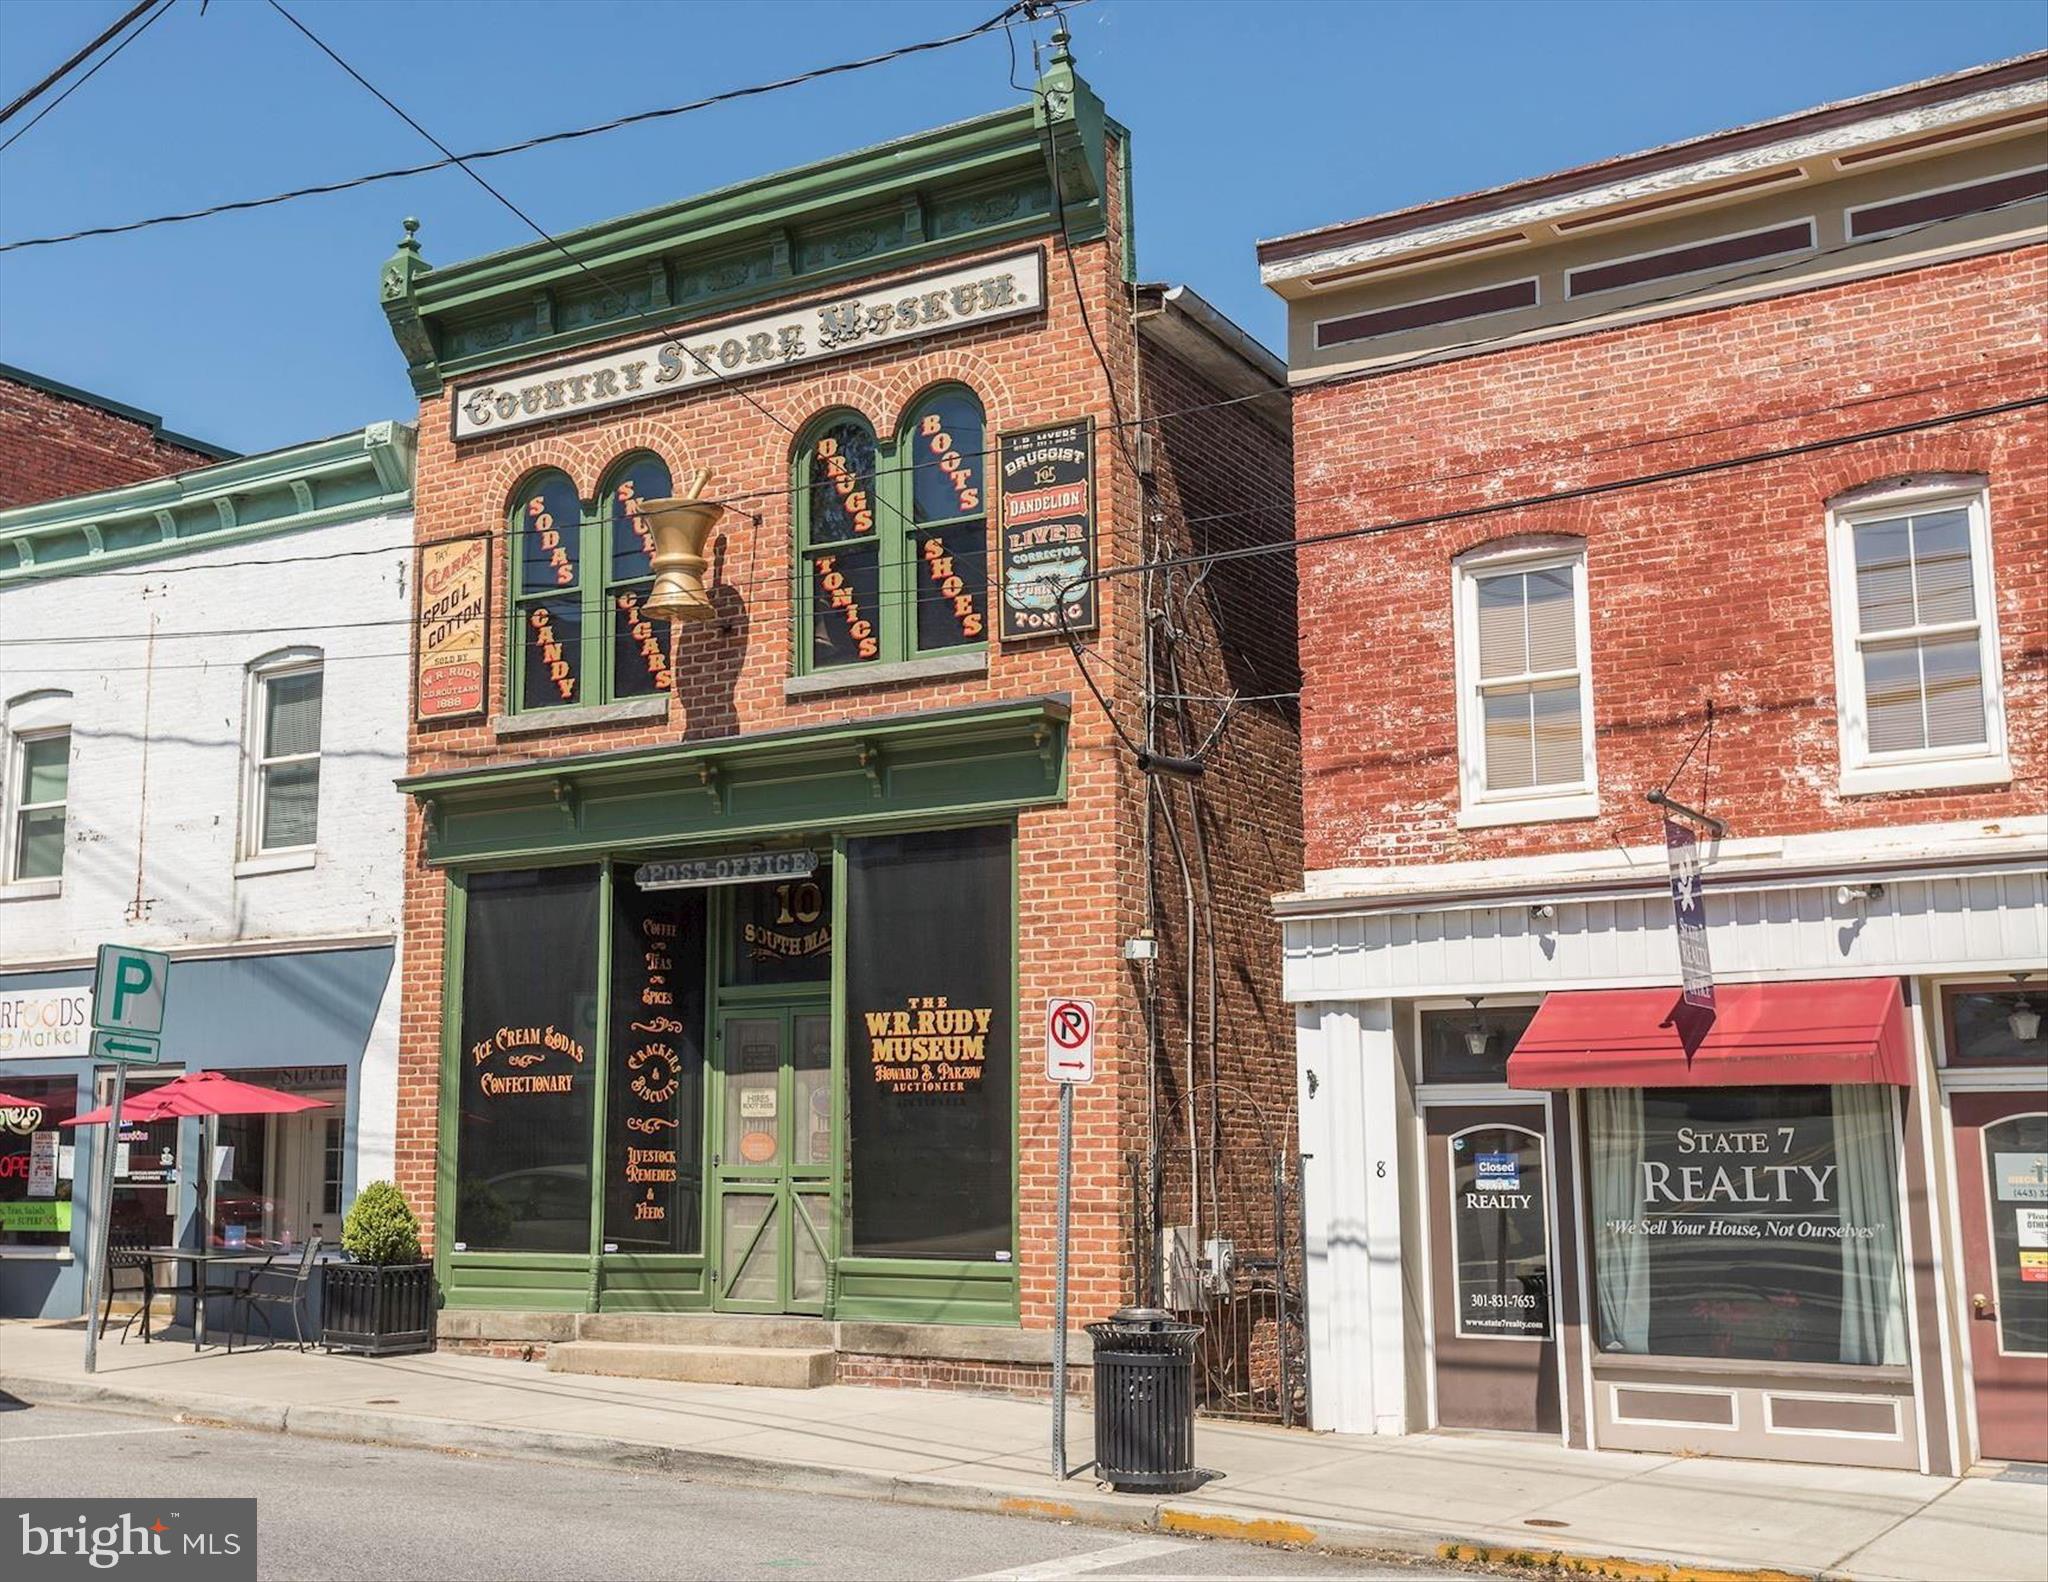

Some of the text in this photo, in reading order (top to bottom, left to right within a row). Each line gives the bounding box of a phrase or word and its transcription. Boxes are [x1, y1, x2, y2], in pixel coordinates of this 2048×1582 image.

[463, 360, 648, 425] COUNTRY
[655, 324, 806, 383] STORE
[921, 414, 978, 510] BOOTS
[1005, 448, 1085, 476] DRUGGIST
[818, 438, 872, 533] DRUGS
[1009, 490, 1080, 517] DANDELION
[618, 480, 656, 568] SNUF
[529, 496, 573, 584] SODAS
[1009, 524, 1086, 552] LIVER
[1013, 546, 1081, 564] CORRECTOR
[924, 537, 982, 636] SHOES
[423, 584, 470, 629] SPOOL
[816, 555, 877, 658] TONICS
[428, 598, 482, 649] COTTON
[617, 592, 672, 689] CIGARS
[435, 656, 454, 665] SOLD
[531, 608, 575, 699] CANDY
[449, 667, 479, 680] RUDY
[437, 697, 461, 708] 1888
[776, 883, 822, 924] 10
[745, 923, 800, 955] SOUTH
[645, 953, 672, 970] TEAS
[112, 956, 152, 1020] P
[642, 988, 673, 1005] SPICES
[908, 996, 948, 1009] THE
[20, 1030, 78, 1048] Market
[472, 1025, 584, 1066] ICE CREAM SODAS
[872, 1036, 985, 1062] MUSEUM
[628, 1043, 682, 1073] CRACKERS
[481, 1072, 573, 1096] CONFECTIONARY
[652, 1067, 660, 1080] &
[874, 1065, 919, 1082] HOWARD
[937, 1062, 982, 1080] PARZOW
[631, 1076, 679, 1103] BISCUITS
[892, 1082, 965, 1092] AUCTIONEER
[1677, 1127, 1795, 1154] STATE 7
[0, 1156, 30, 1178] OPE
[627, 1147, 676, 1164] LIVESTOCK
[1479, 1161, 1514, 1172] Closed
[626, 1164, 677, 1183] REMEDIES
[1376, 1160, 1386, 1178] 8
[646, 1188, 654, 1200] &
[1642, 1161, 1838, 1203] REALTY
[635, 1202, 665, 1220] FEEDS
[1466, 1193, 1532, 1209] REALTY
[1639, 1220, 1666, 1235] Sell
[1670, 1220, 1705, 1236] Your
[1708, 1220, 1762, 1238] House,
[1765, 1221, 1796, 1237] Not
[1471, 1294, 1535, 1308] 301-831-7653
[1465, 1319, 1543, 1330] www.state7realty.com
